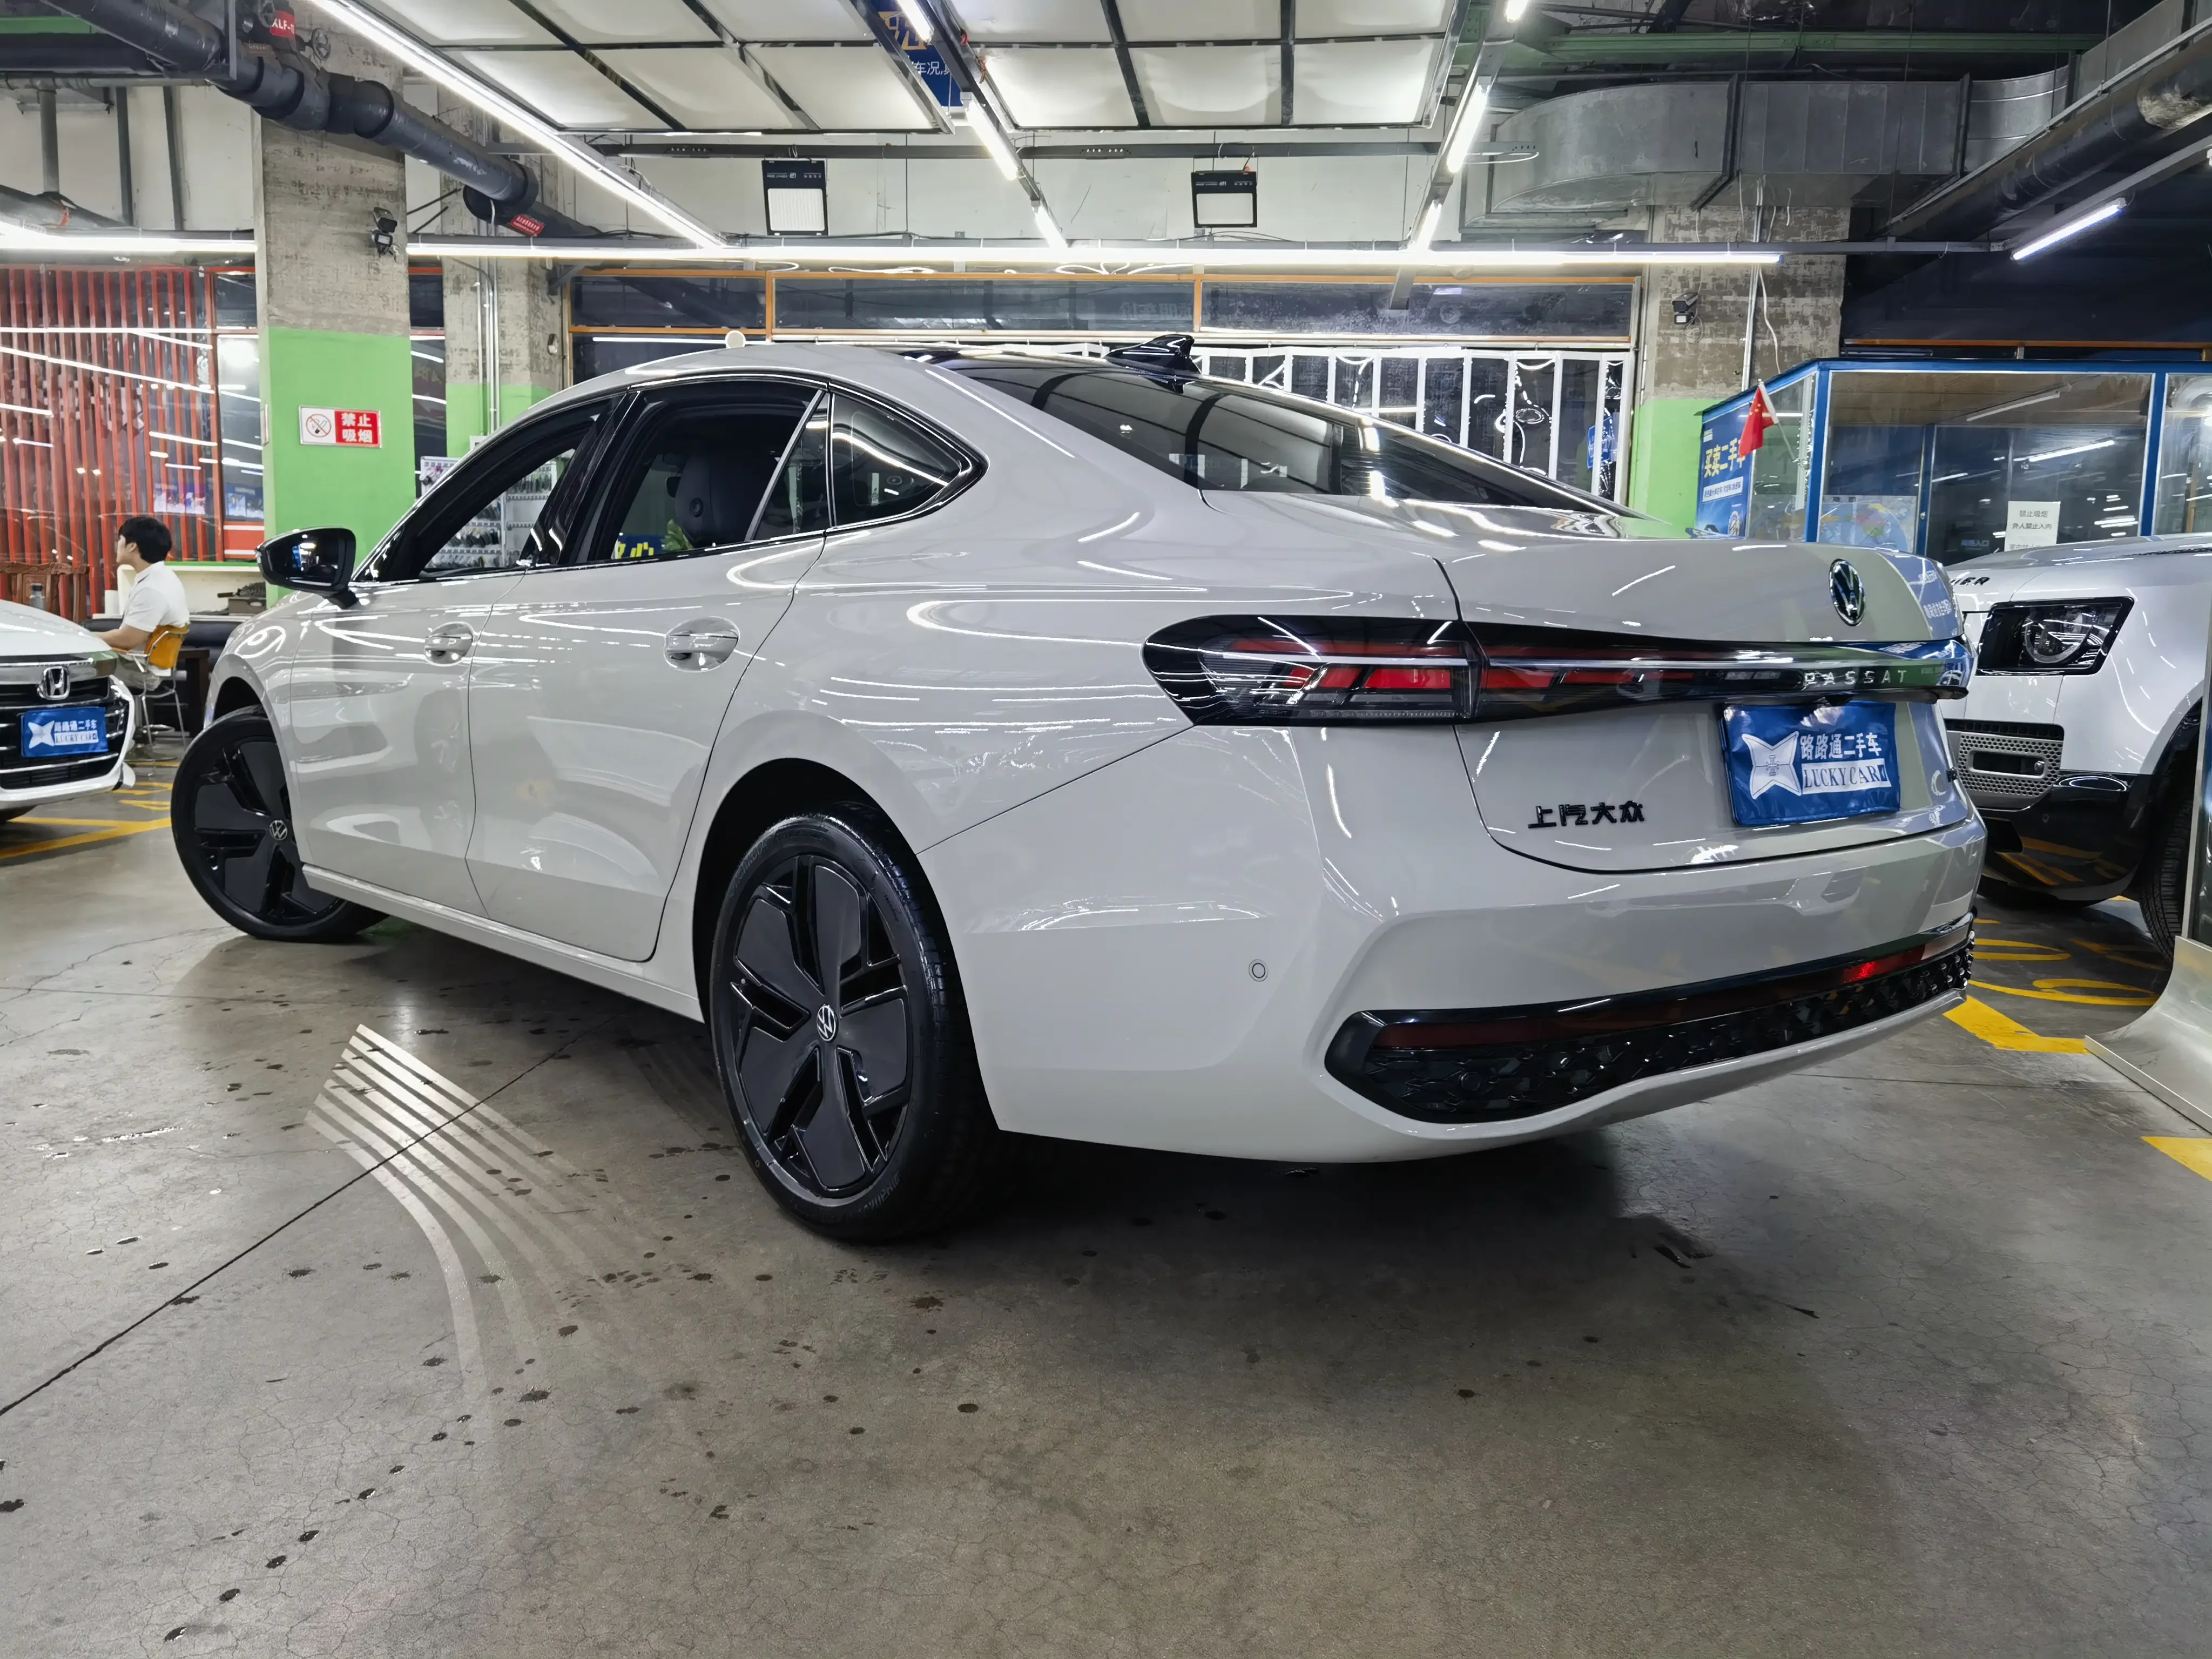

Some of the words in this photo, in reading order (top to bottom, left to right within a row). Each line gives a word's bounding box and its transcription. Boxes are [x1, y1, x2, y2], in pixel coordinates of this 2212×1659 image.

[341, 413, 372, 427] 禁止
[342, 429, 373, 443] 吸烟
[2020, 510, 2048, 518] 禁止吸烟
[56, 733, 78, 744] LUCKY
[1800, 732, 1882, 760] 路路通二手车
[1803, 767, 1847, 788] LUCKY
[1528, 800, 1645, 829] 上汽大众
